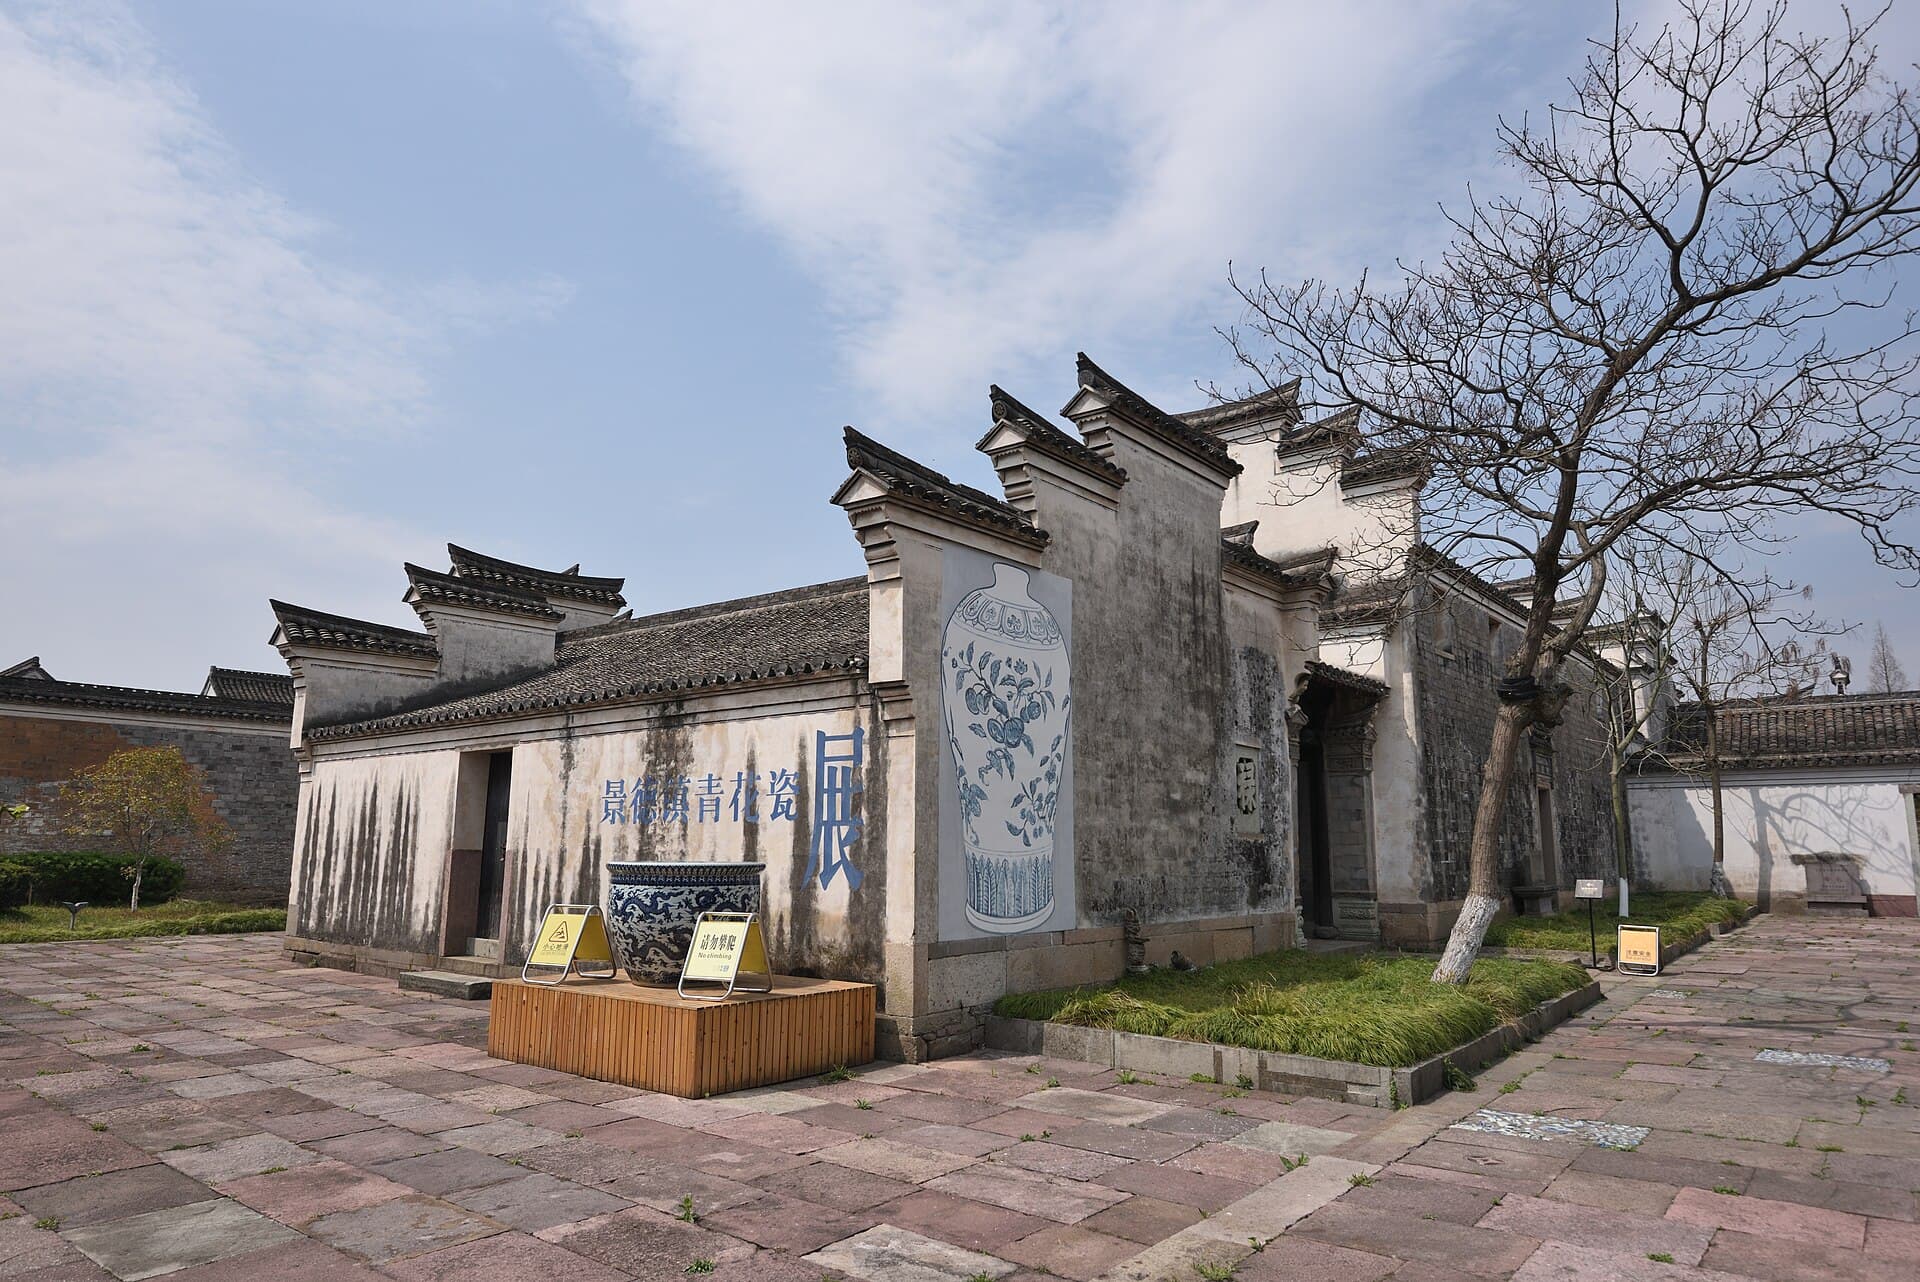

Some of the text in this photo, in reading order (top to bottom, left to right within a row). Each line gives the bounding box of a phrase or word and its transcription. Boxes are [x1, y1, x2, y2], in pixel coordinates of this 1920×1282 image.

[600, 726, 865, 891] 景德镇青花瓷 展
[700, 934, 737, 951] 请勿攀爬
[707, 953, 732, 961] climbing
